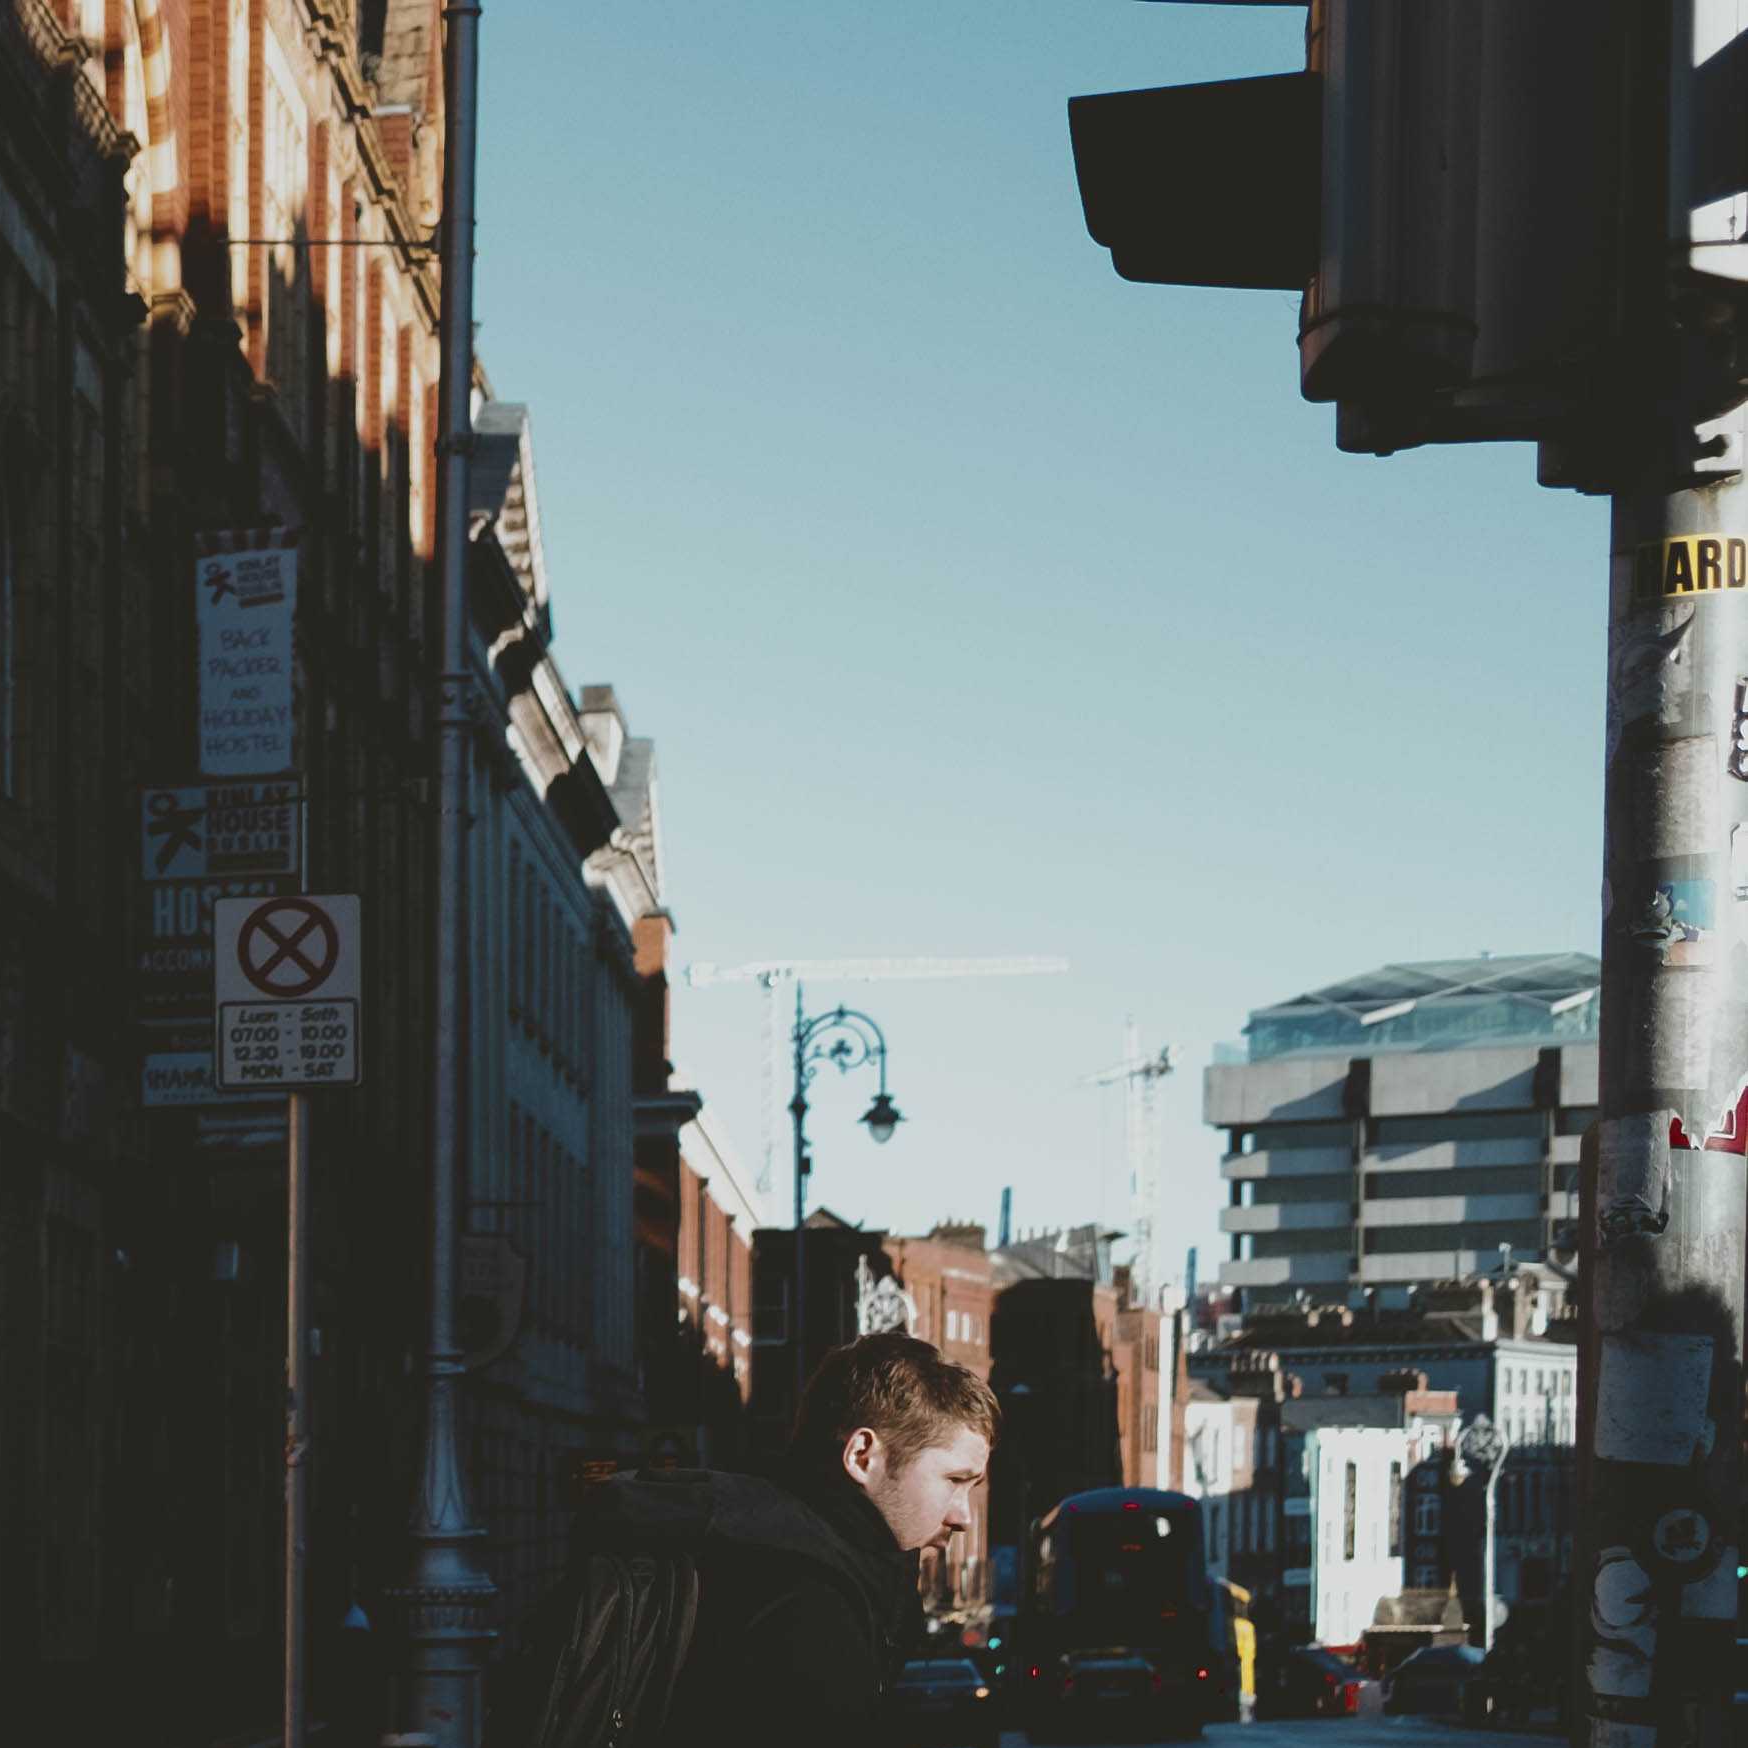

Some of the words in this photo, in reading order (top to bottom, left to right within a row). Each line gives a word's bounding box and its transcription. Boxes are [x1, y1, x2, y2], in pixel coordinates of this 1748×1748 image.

[203, 706, 288, 729] HOLIDAY
[205, 734, 285, 756] HOSTEL
[207, 809, 289, 834] HOUSE
[241, 1064, 283, 1079] MON
[304, 1061, 336, 1078] SAT
